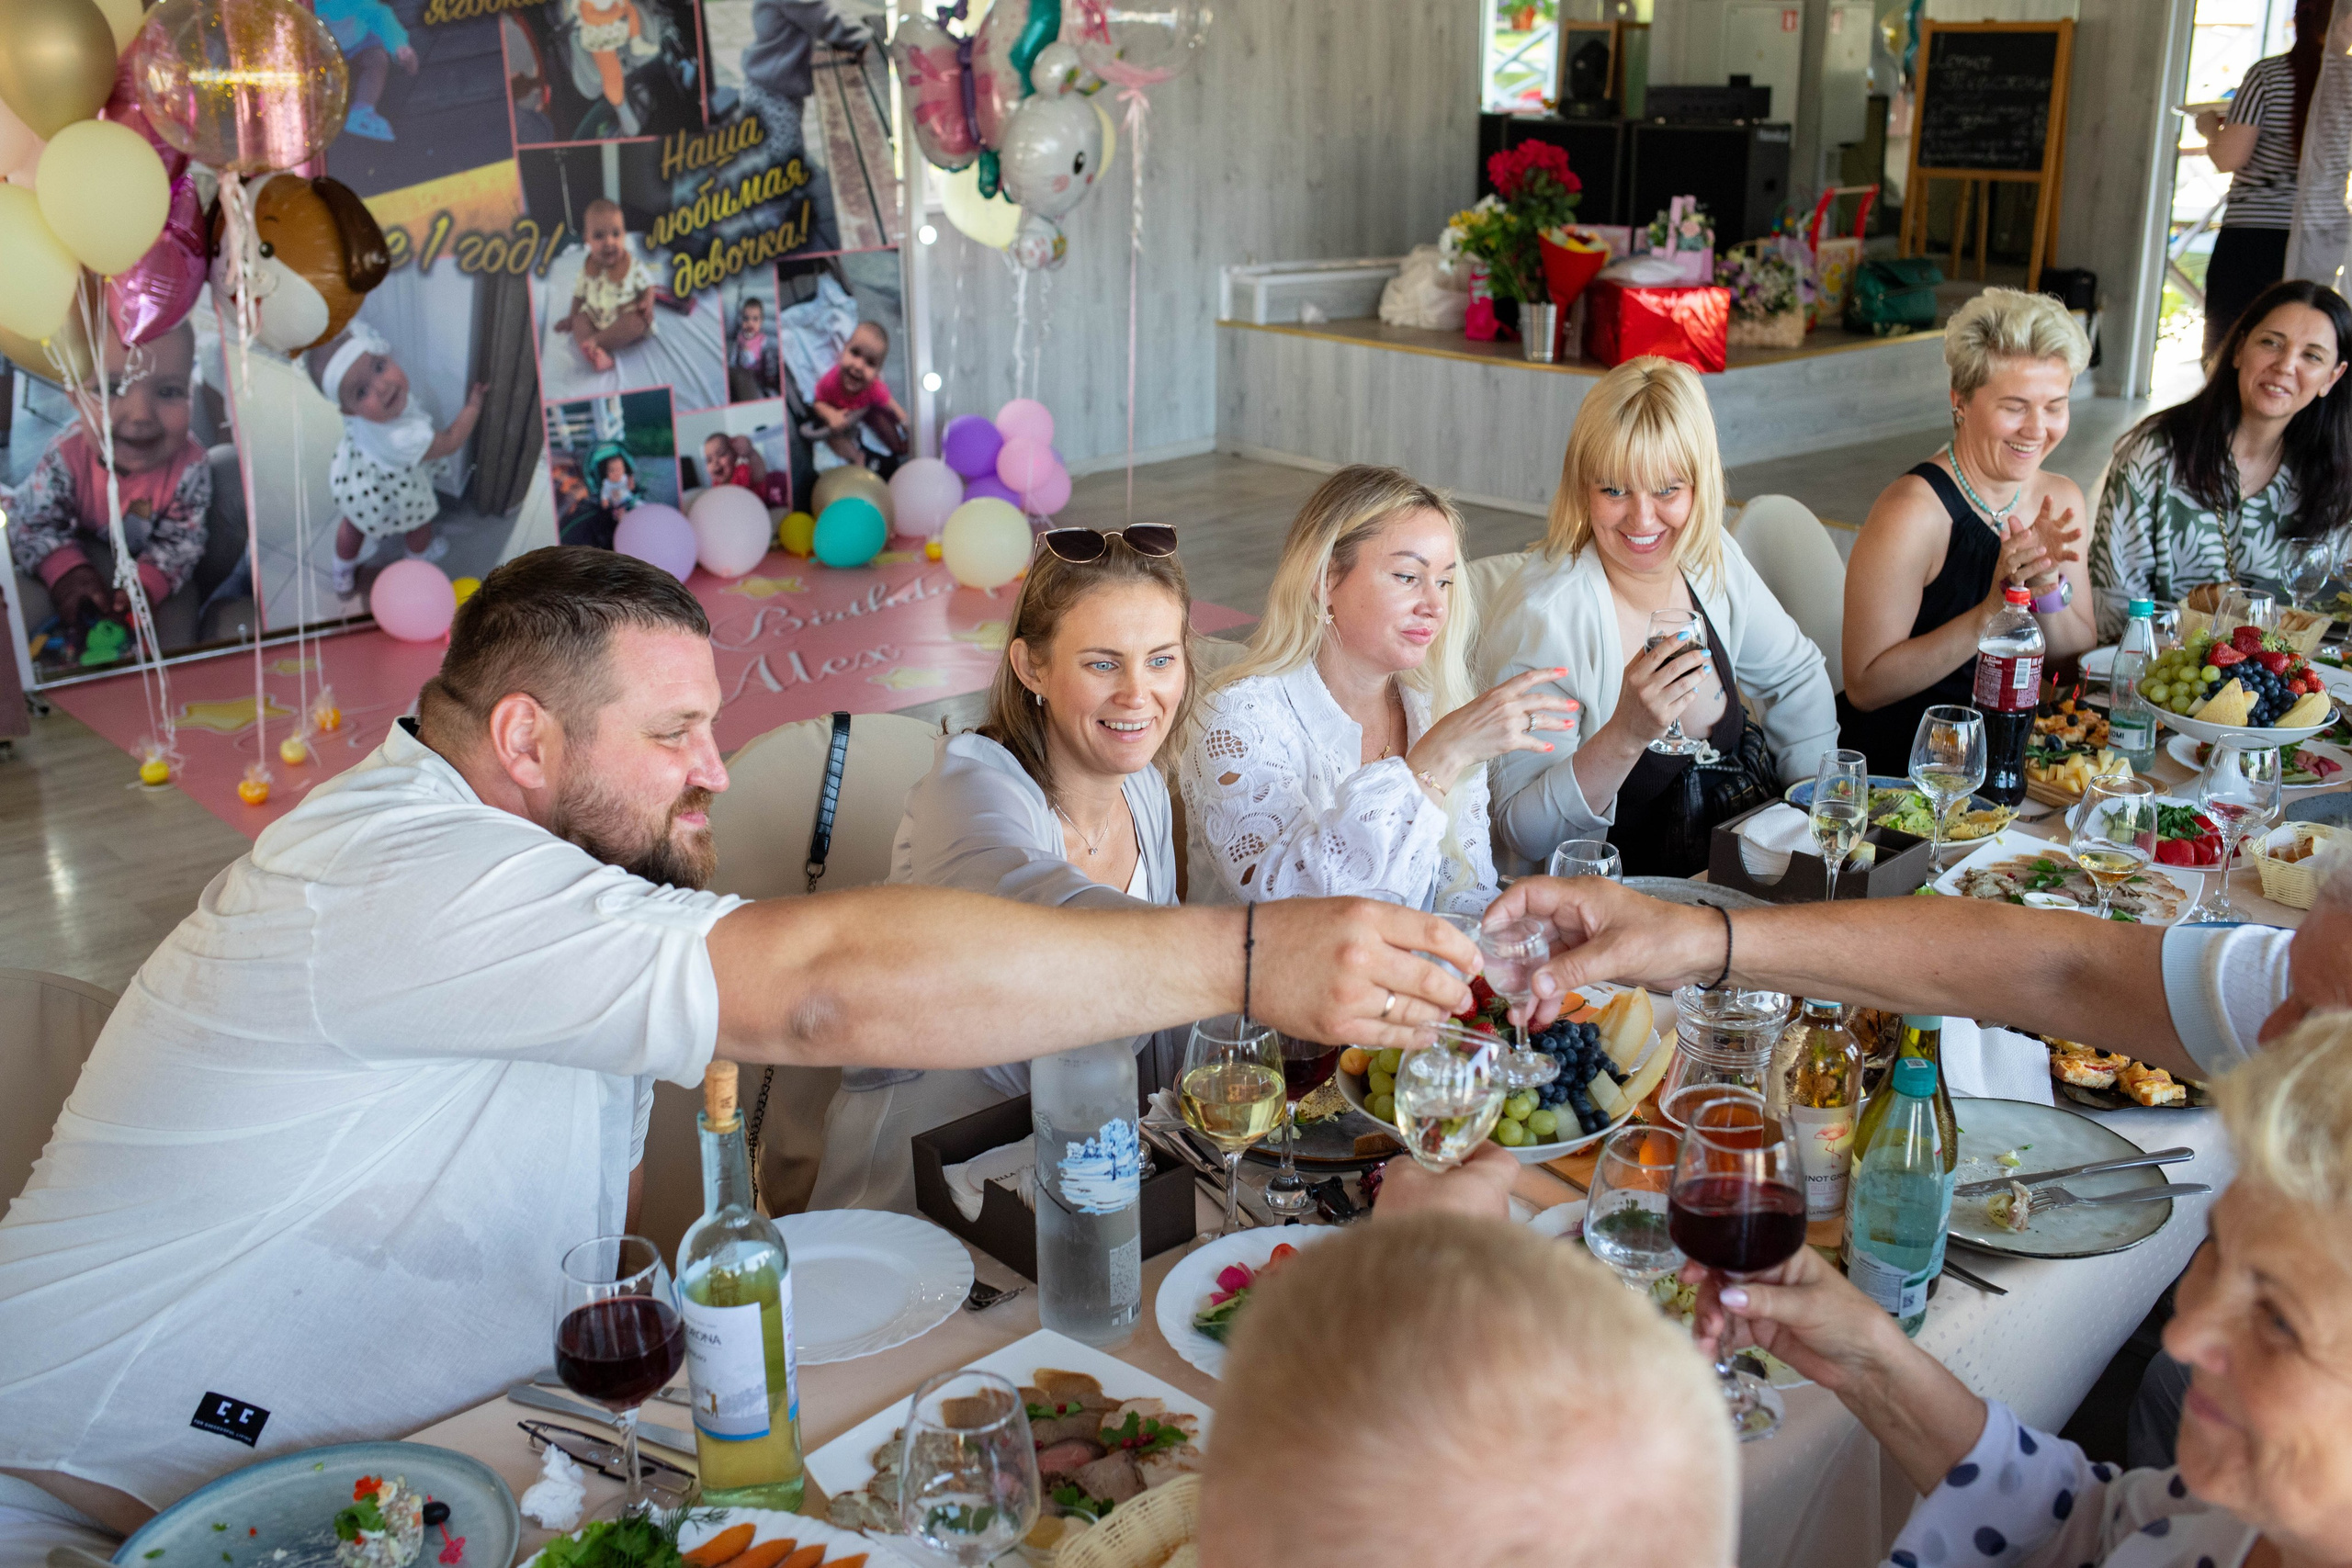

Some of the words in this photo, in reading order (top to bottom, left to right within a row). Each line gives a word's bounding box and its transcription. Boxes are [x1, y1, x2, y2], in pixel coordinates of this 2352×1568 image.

[661, 116, 764, 181] Наша
[645, 158, 809, 251] любимая
[422, 216, 449, 269] 1
[458, 219, 566, 275] год!
[672, 198, 810, 299] девочка!
